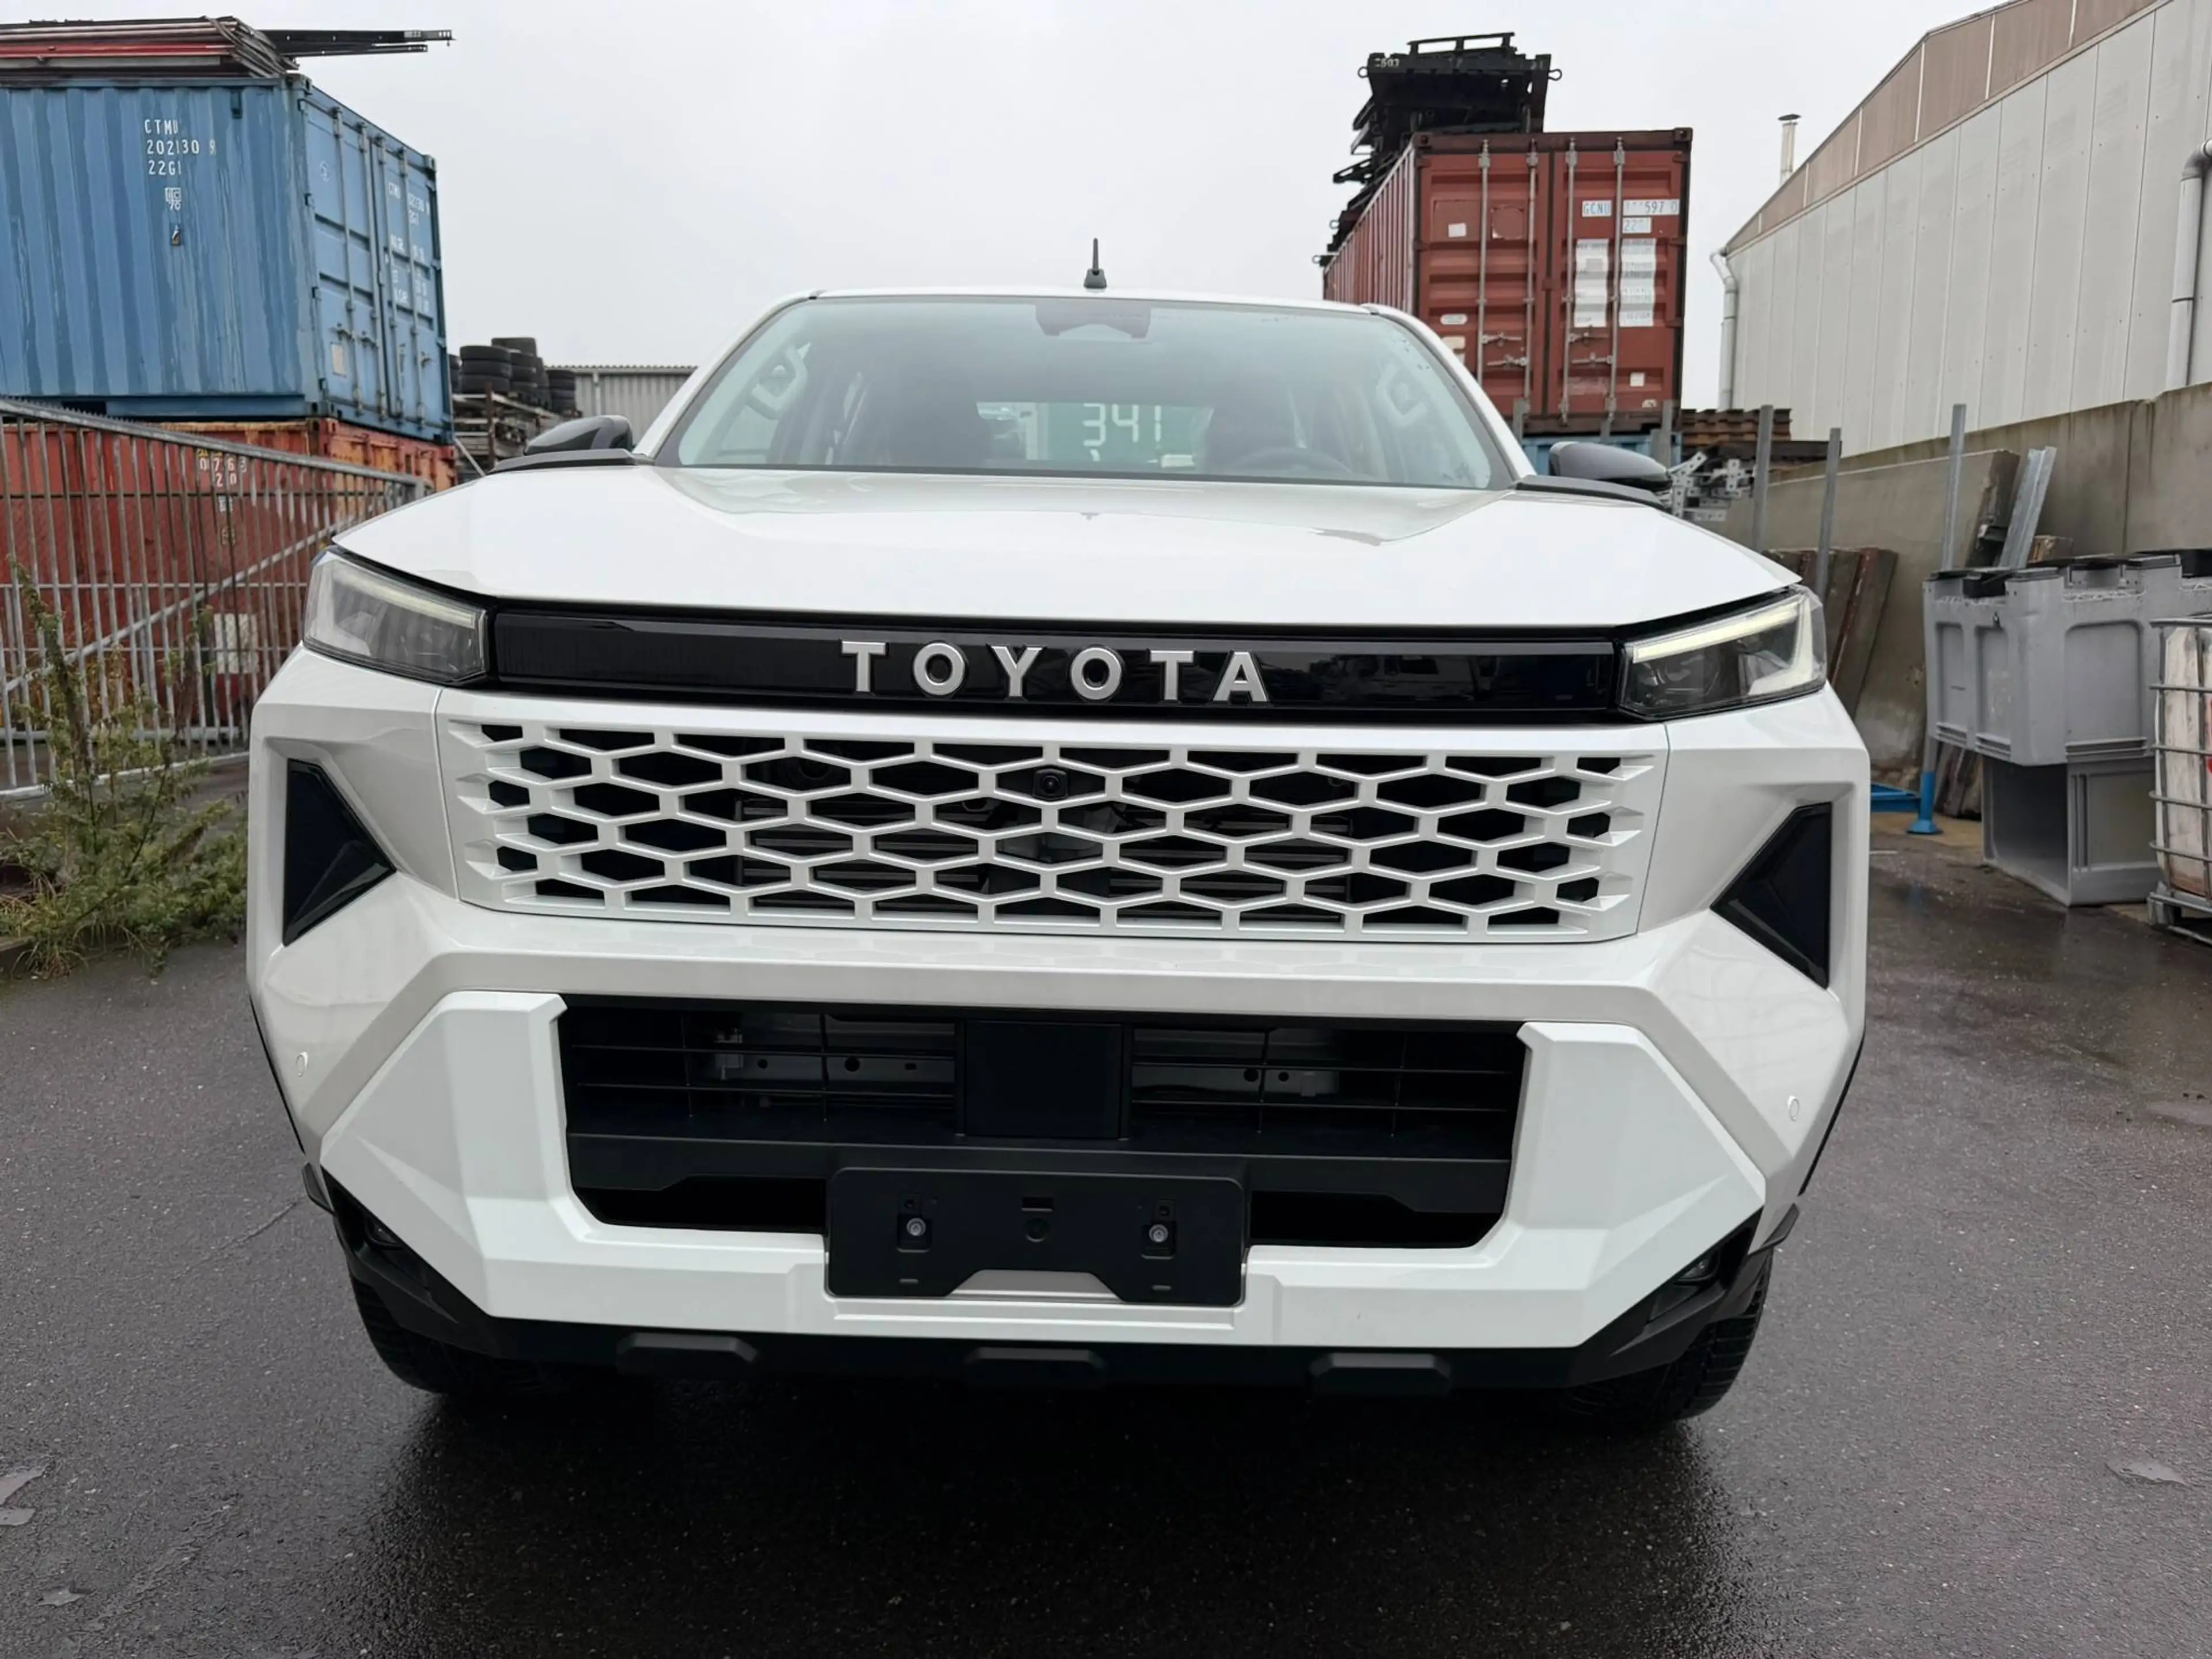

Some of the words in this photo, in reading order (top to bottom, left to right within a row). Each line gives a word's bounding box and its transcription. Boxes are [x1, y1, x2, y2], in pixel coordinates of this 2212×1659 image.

[144, 119, 179, 135] CTMU
[146, 139, 200, 156] 202130
[148, 160, 182, 176] 22G1
[841, 641, 1268, 702] TOYOTA
